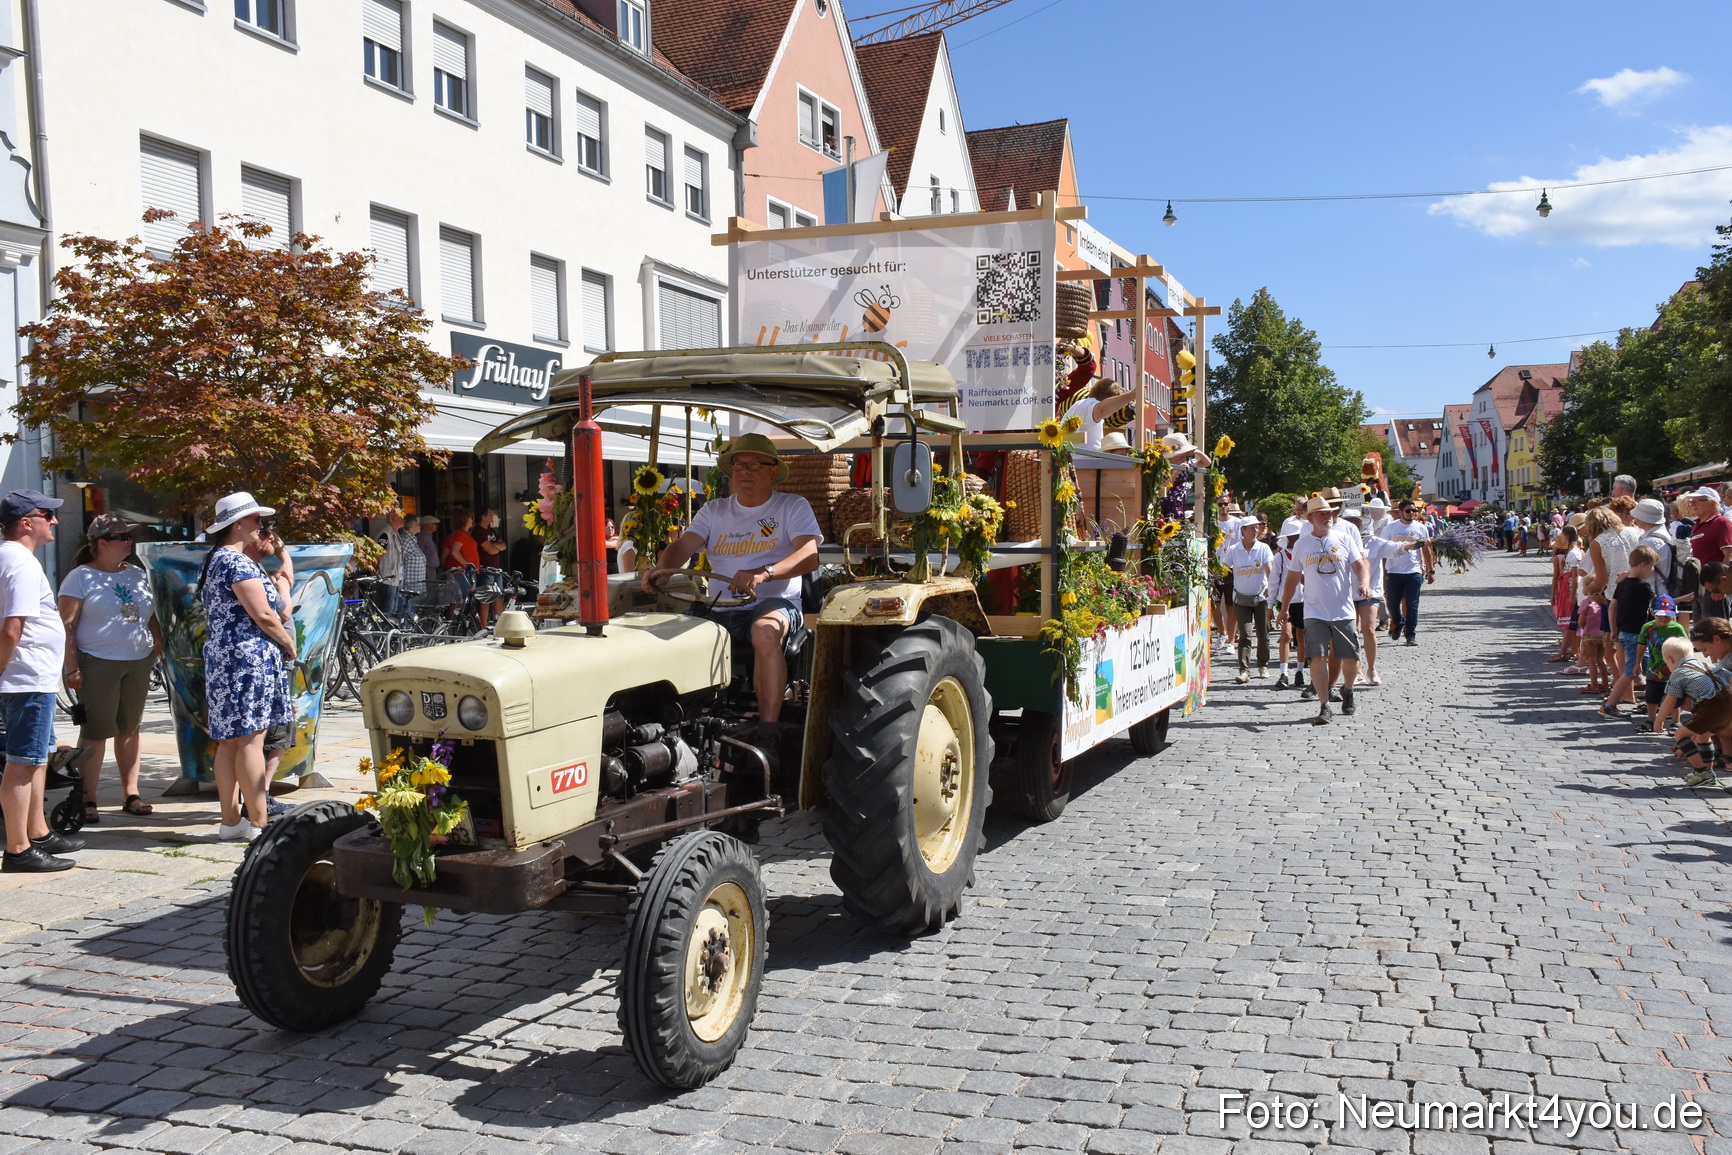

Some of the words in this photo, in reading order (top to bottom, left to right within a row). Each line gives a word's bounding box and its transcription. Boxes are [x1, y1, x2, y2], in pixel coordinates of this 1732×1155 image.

[747, 267, 827, 281] Unterstützer
[830, 262, 882, 278] gesucht
[884, 261, 907, 273] für:
[783, 320, 799, 333] Das
[800, 318, 841, 333] Neumarkter
[1002, 333, 1035, 341] SCHAFFEN
[966, 345, 1053, 368] MEHR
[968, 387, 1028, 397] Raiffeisenbank
[968, 398, 1009, 407] Neumarkt
[1041, 396, 1053, 404] eG
[713, 533, 778, 558] Honighaus
[1129, 637, 1141, 672] 125
[1149, 668, 1174, 699] Neumarkt
[422, 693, 430, 703] D
[553, 764, 586, 791] 770
